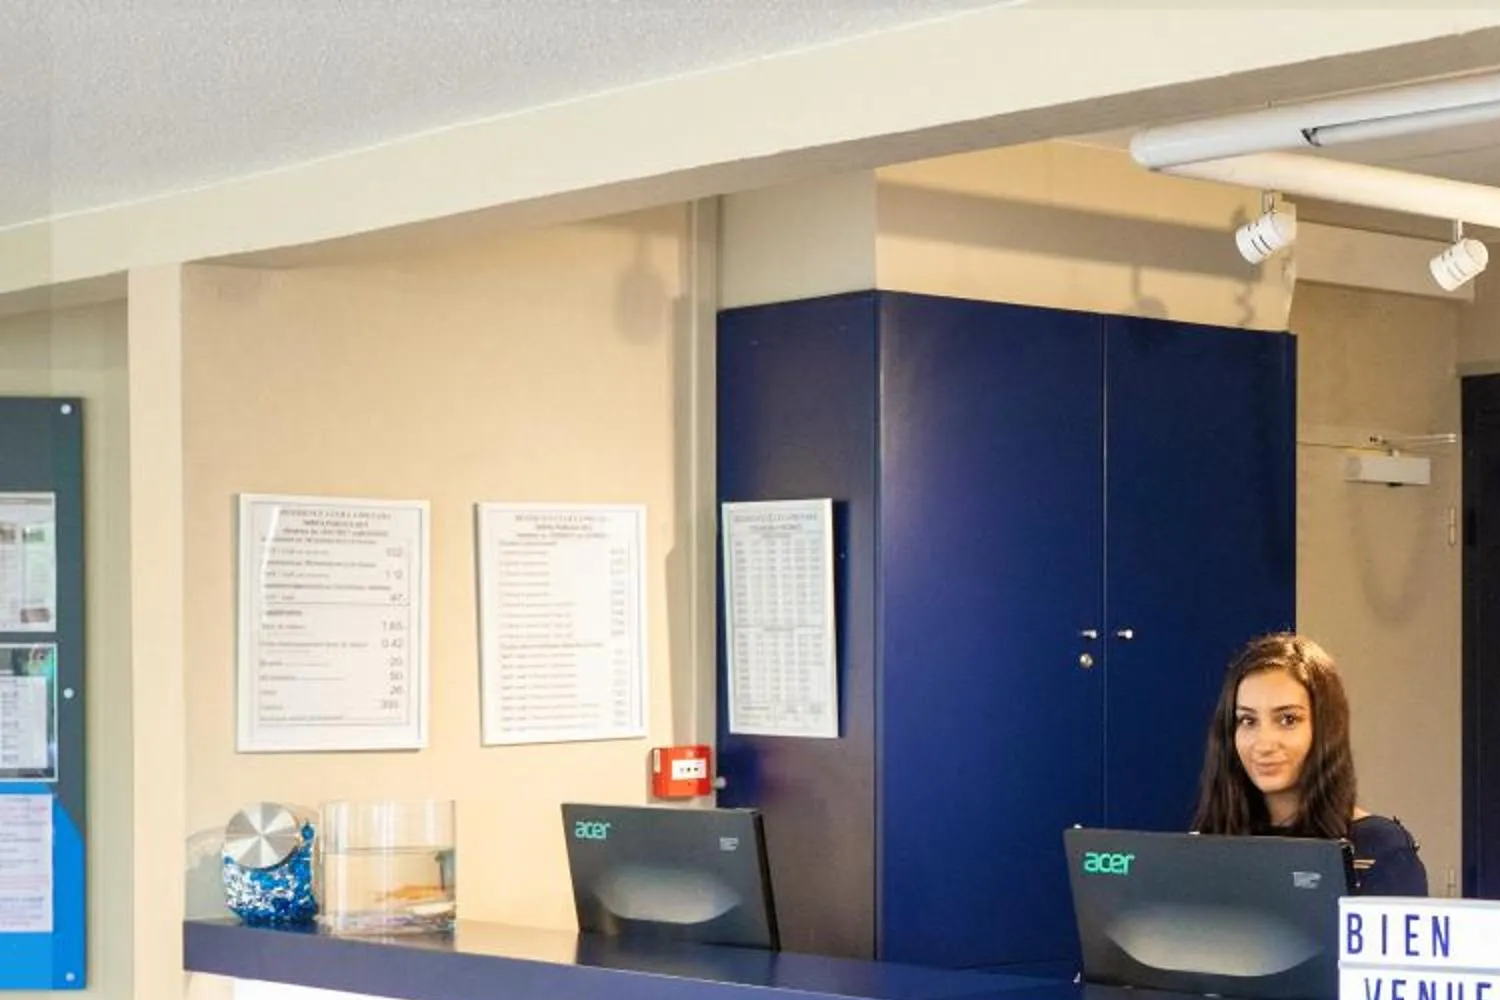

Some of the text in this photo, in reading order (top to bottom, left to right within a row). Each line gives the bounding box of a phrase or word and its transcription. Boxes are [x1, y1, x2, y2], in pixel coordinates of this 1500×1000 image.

[575, 821, 611, 839] acer
[1083, 851, 1135, 875] acer
[1346, 912, 1450, 957] BIEN
